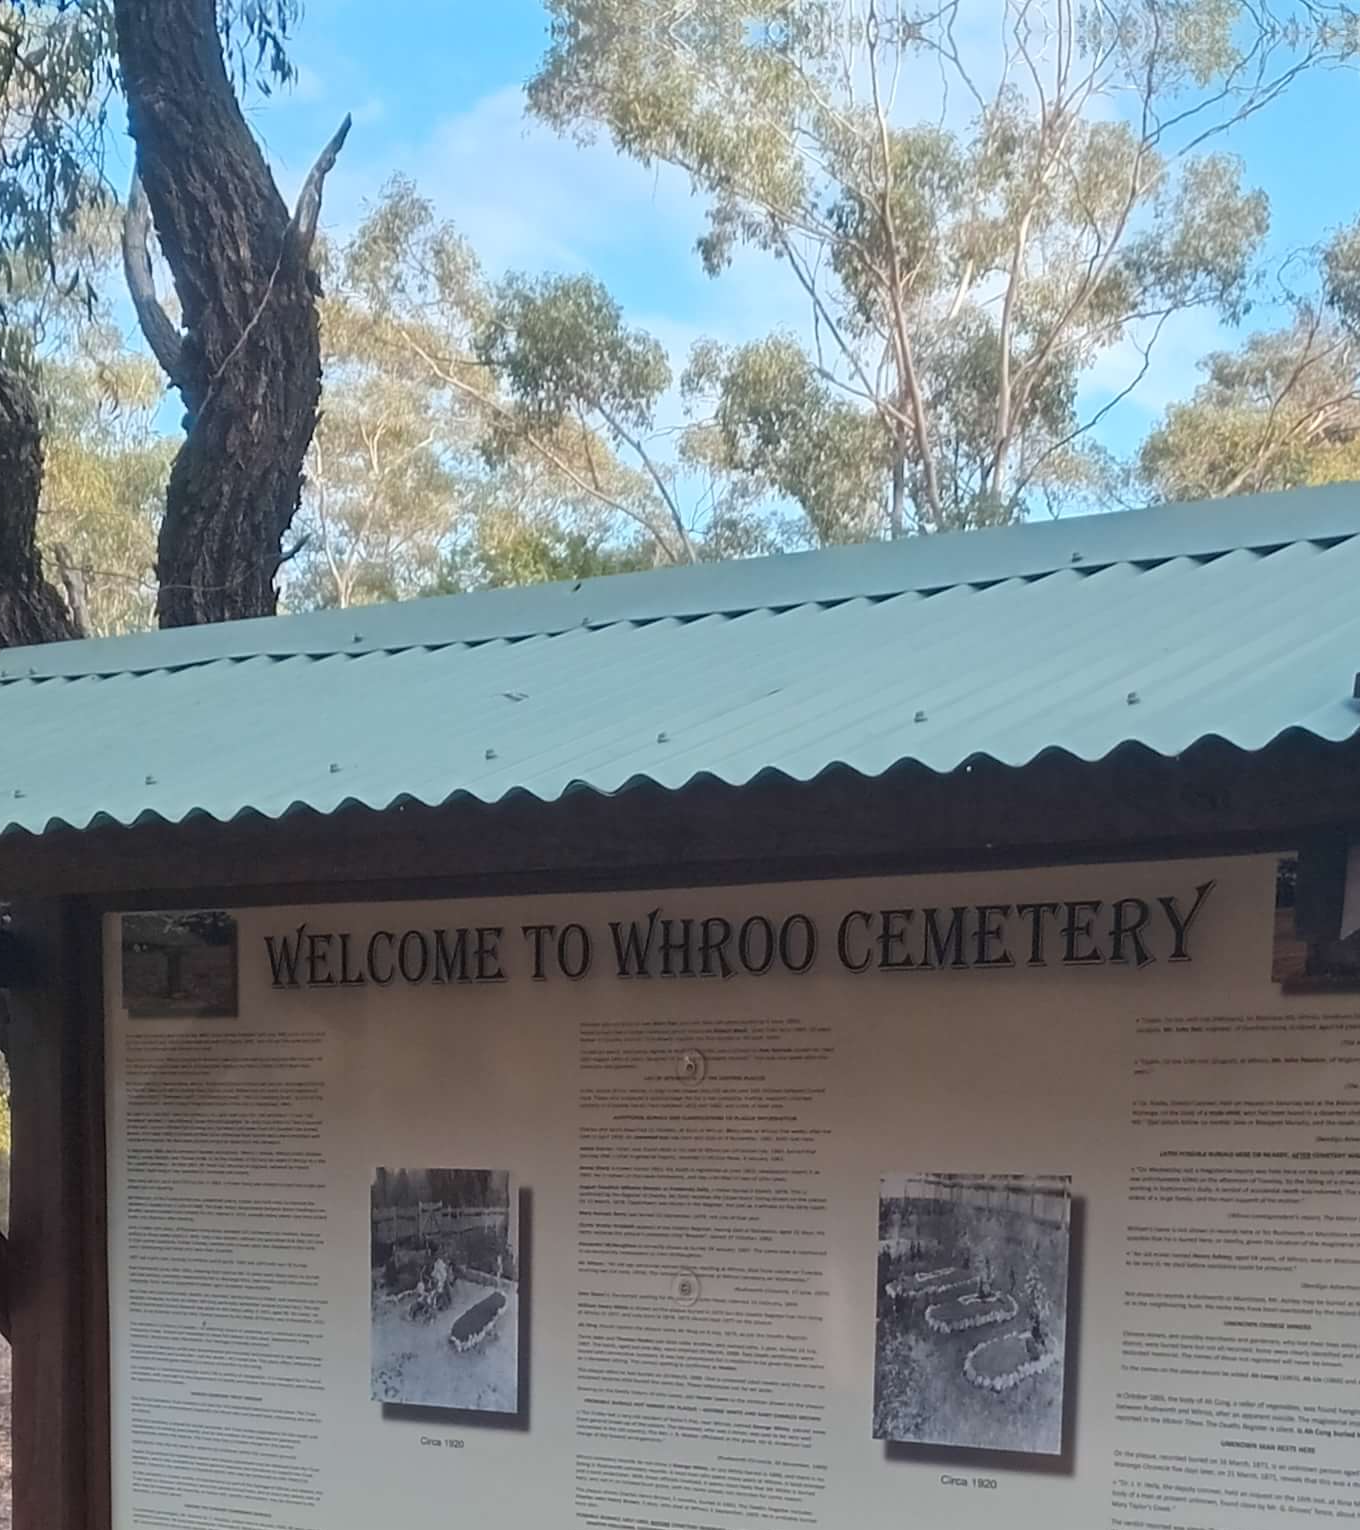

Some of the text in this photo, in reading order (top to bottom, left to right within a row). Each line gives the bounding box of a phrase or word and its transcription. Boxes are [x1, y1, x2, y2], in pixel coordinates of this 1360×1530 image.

[264, 880, 1217, 987] WELCOME TO WHROO CEMETERY
[940, 1475, 968, 1486] Circa
